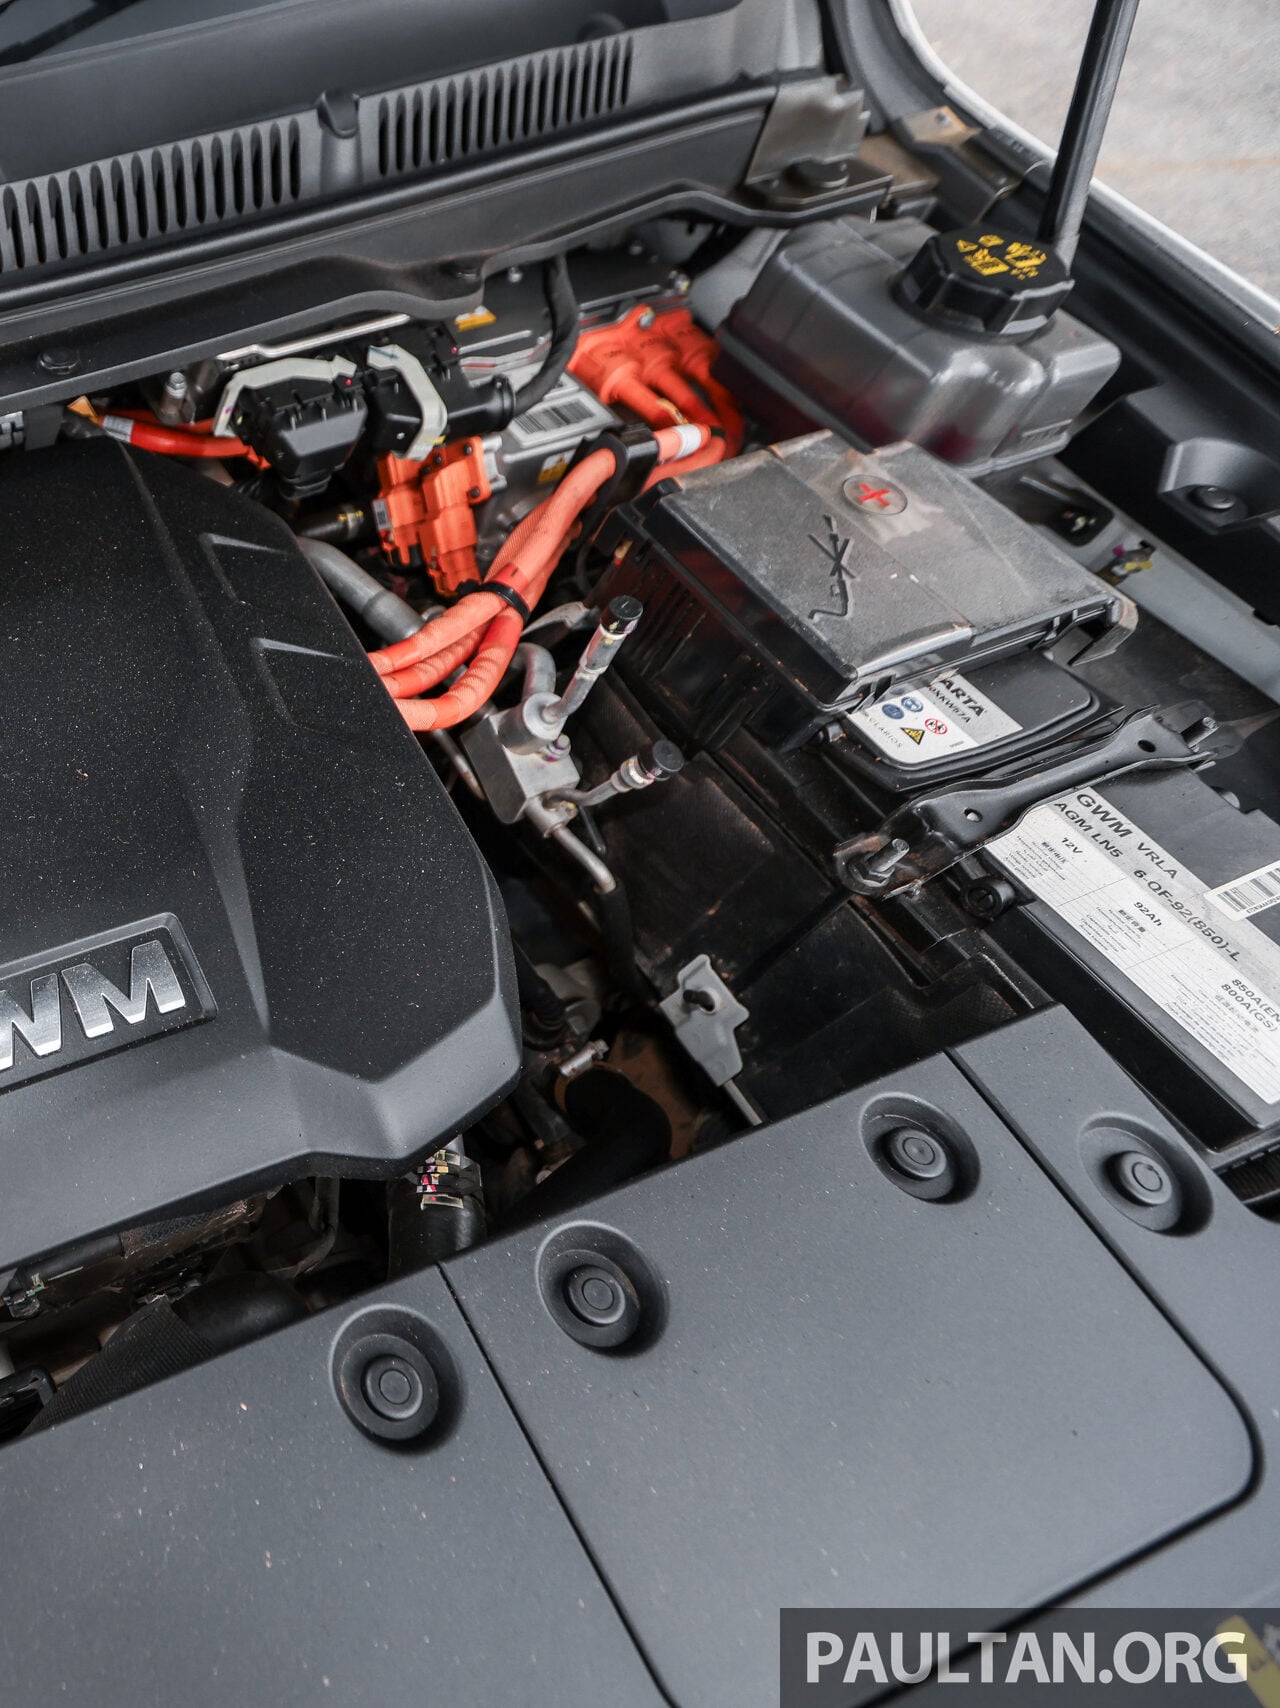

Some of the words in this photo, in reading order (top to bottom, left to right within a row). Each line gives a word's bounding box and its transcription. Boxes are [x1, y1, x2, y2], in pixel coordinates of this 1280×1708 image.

[939, 679, 985, 718] ARTA
[1054, 802, 1093, 832] AGM
[1091, 833, 1123, 858] LN5
[1061, 837, 1083, 854] 12V
[1076, 793, 1133, 838] GWM
[1137, 842, 1179, 879] VRLA
[1133, 902, 1162, 926] 92Ah
[1221, 983, 1278, 1032] 800A(GS)
[1231, 978, 1280, 1023] 850A(EN
